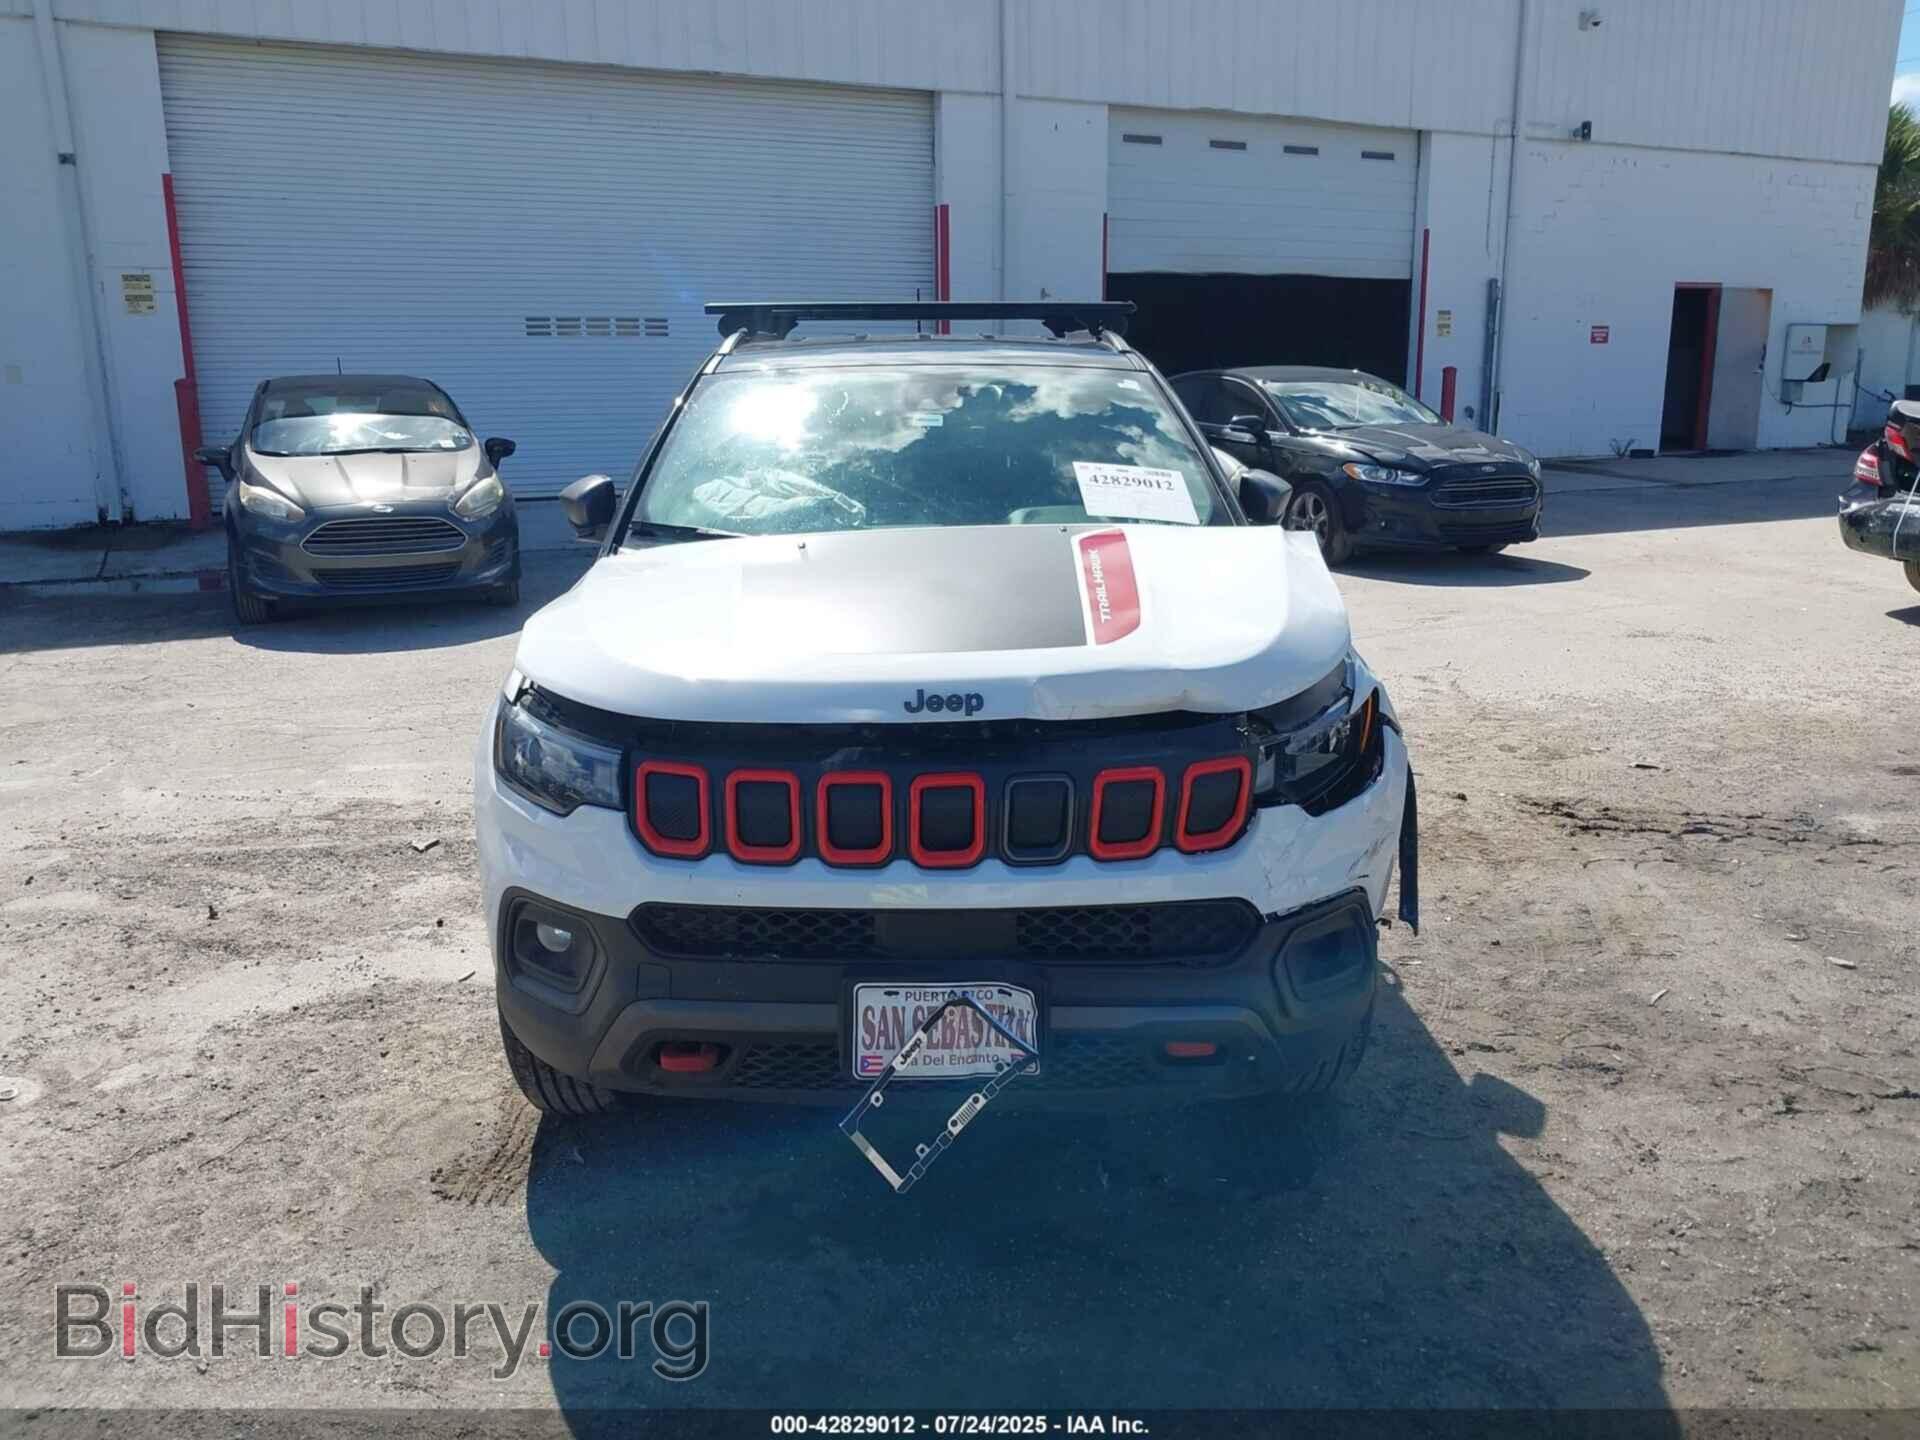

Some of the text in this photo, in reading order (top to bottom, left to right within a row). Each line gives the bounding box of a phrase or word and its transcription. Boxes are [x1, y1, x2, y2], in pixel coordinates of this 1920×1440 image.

[1089, 474, 1175, 491] 42829012
[903, 688, 984, 716] Jeep
[862, 1005, 906, 1050] SAN
[900, 1038, 922, 1065] Jeep
[923, 1054, 944, 1066] Del
[949, 1053, 999, 1066] Encanto
